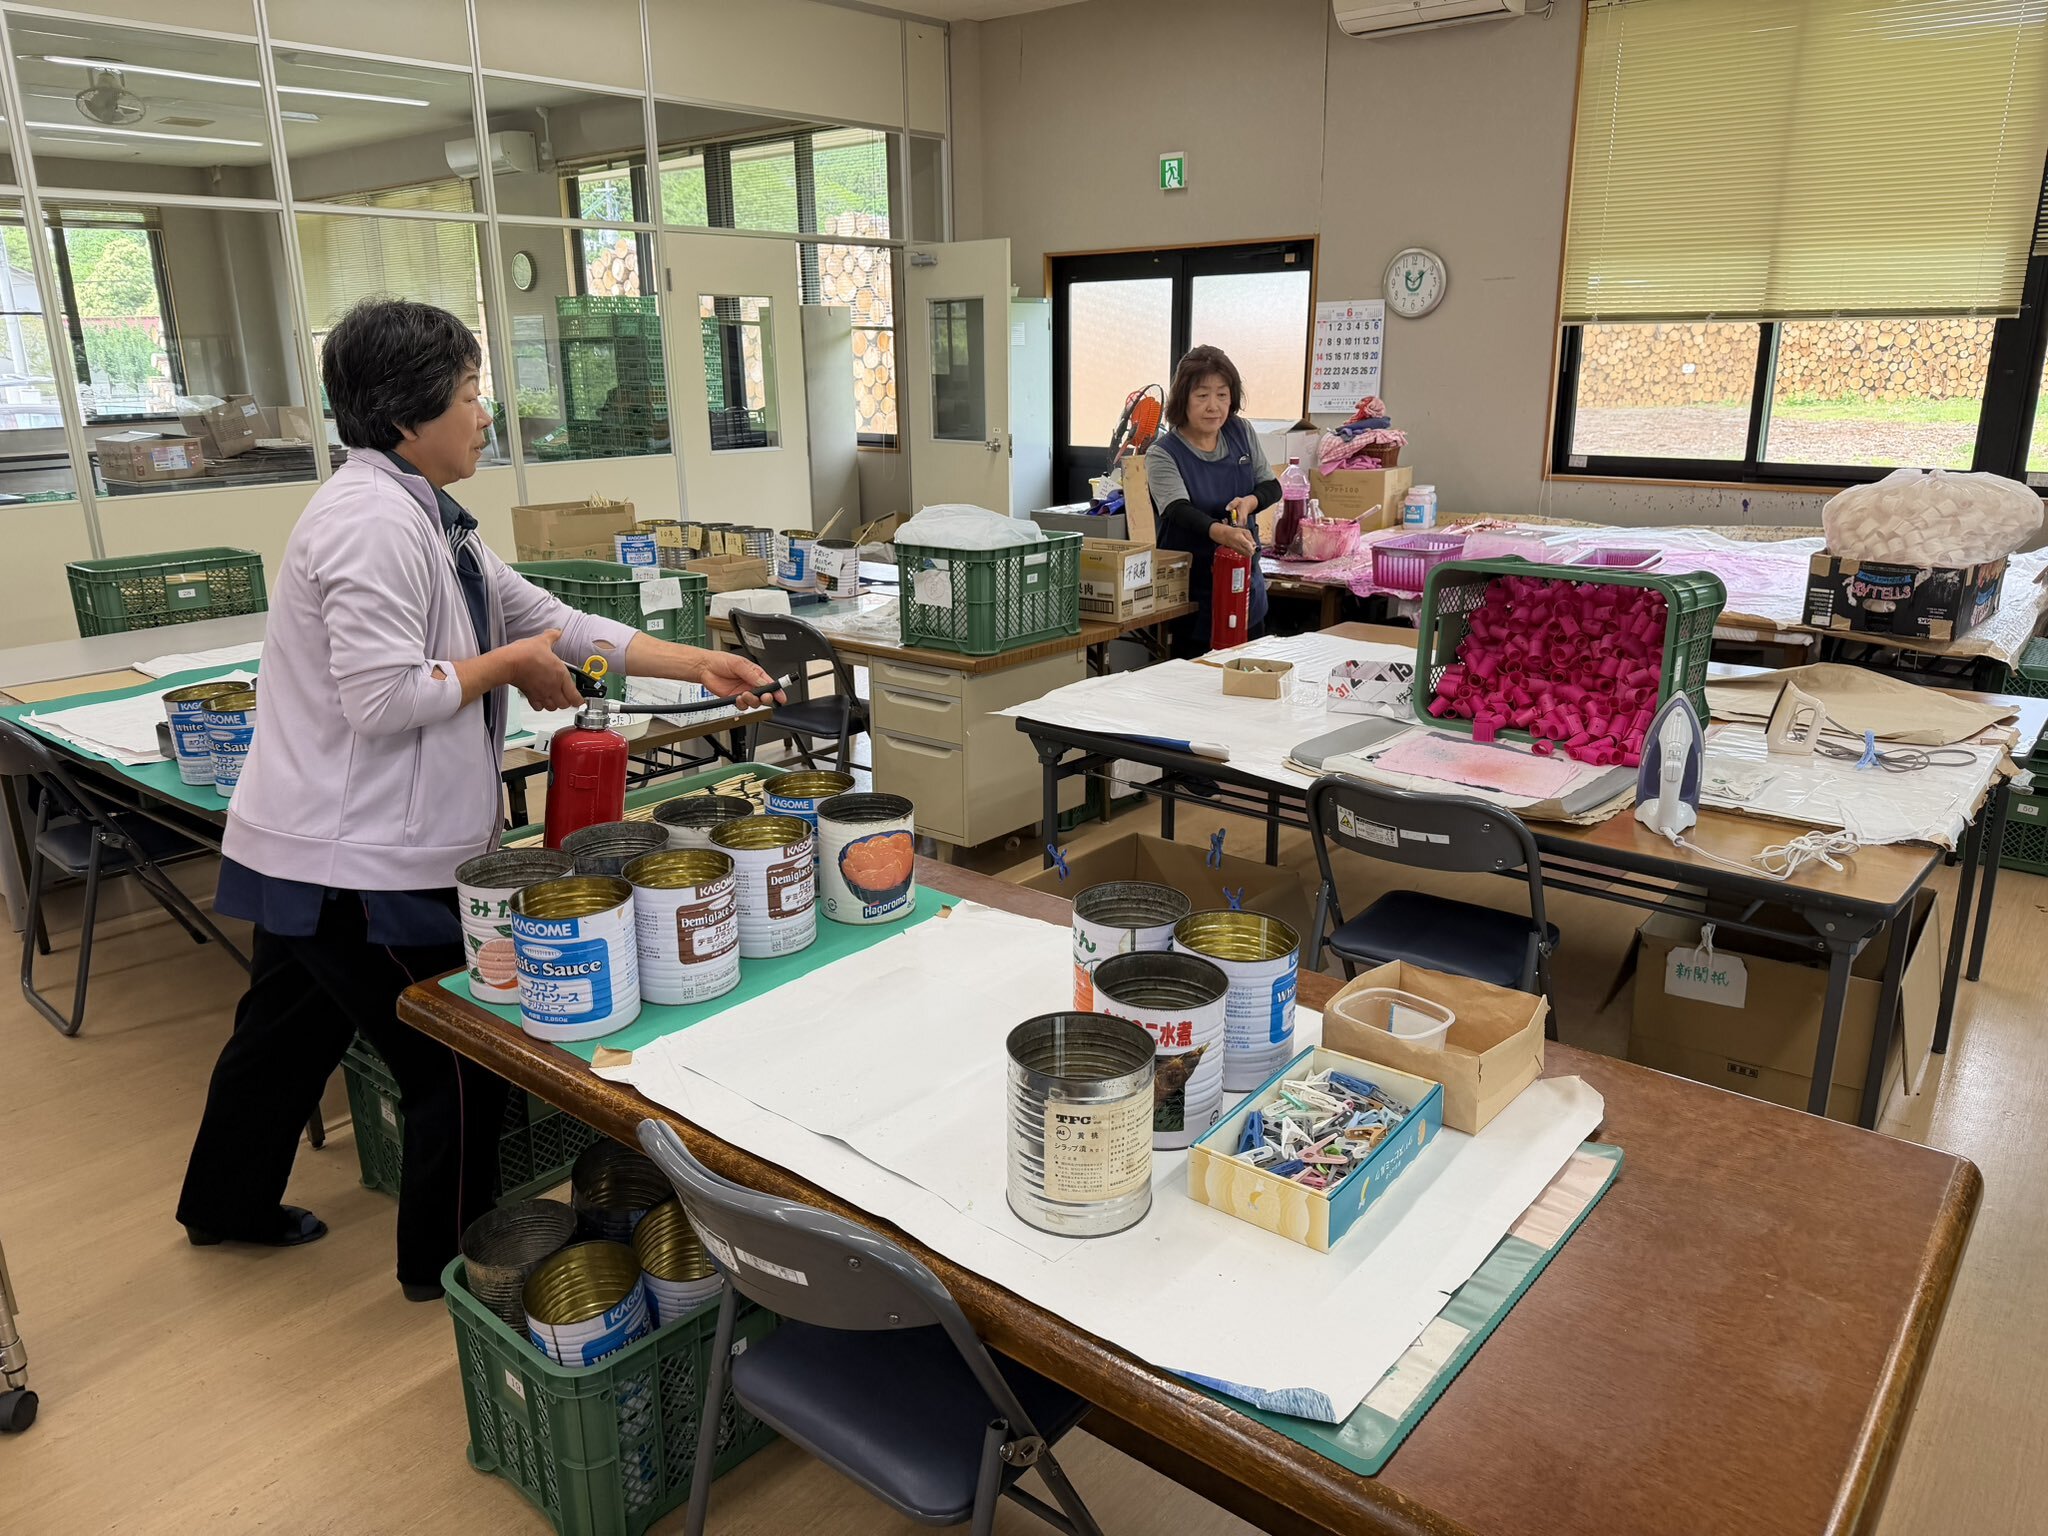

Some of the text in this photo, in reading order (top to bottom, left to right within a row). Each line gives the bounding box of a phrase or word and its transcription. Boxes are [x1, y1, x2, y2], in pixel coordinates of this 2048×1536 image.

[1346, 308, 1353, 317] 6
[1337, 323, 1342, 331] 2
[1355, 322, 1360, 330] 4
[1364, 322, 1370, 330] 5
[1327, 338, 1332, 346] 8
[1336, 338, 1341, 346] 9
[1354, 337, 1360, 345] 11
[1316, 353, 1323, 361] 14
[1343, 352, 1351, 360] 17
[1352, 352, 1360, 360] 18
[1361, 352, 1369, 360] 19
[1323, 367, 1331, 375] 22
[1333, 367, 1340, 375] 23
[1341, 367, 1349, 375] 24
[1351, 367, 1359, 375] 25
[1360, 367, 1368, 375] 26
[1369, 366, 1378, 374] 27
[1389, 662, 1414, 682] 15
[1336, 683, 1350, 698] 31
[180, 702, 202, 711] KAG
[175, 723, 203, 732] White
[224, 742, 250, 752] Sau
[771, 799, 809, 809] KAGOME
[864, 894, 906, 918] Hagoromo
[681, 907, 729, 929] Demiglace
[513, 916, 572, 937] KAGOME
[542, 960, 602, 977] Sauce
[1055, 1113, 1092, 1125] TFC
[1054, 1142, 1088, 1153] シラップ漬
[609, 1279, 643, 1324] KAGO
